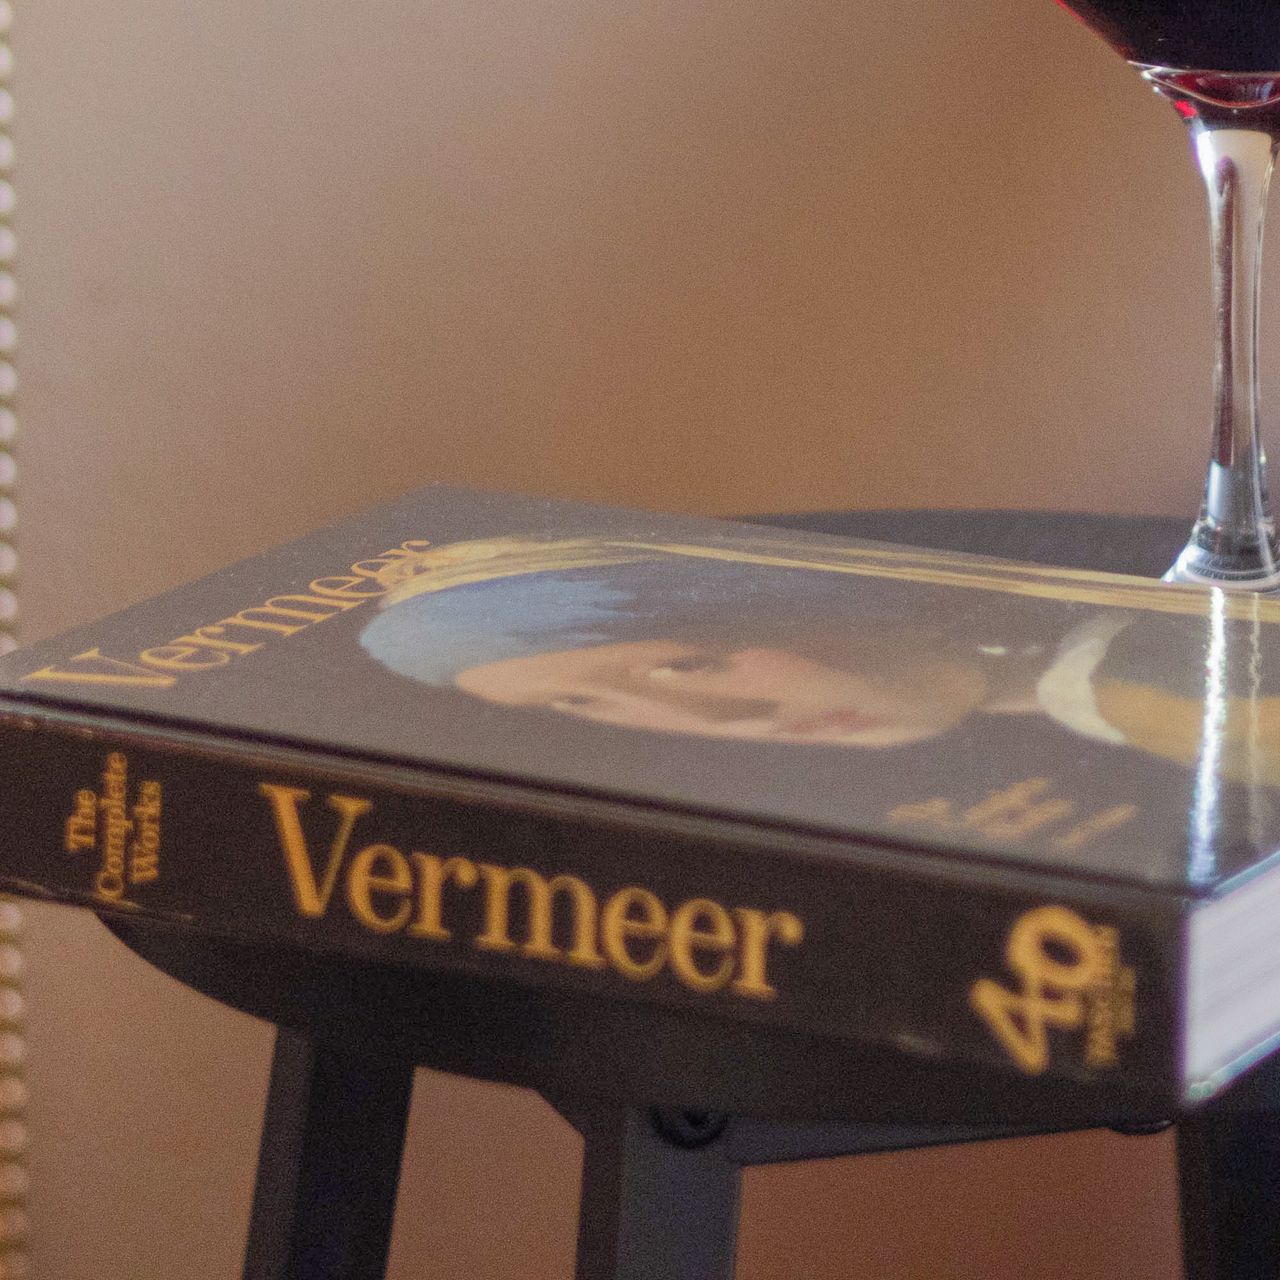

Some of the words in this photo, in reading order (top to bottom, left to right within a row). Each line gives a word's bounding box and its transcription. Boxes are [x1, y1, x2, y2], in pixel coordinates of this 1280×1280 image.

[22, 539, 431, 688] Vermeer
[65, 788, 97, 852] The
[96, 751, 133, 902] Complete
[131, 780, 162, 883] Works
[258, 780, 805, 1001] Vermeer
[969, 904, 1098, 1076] 40
